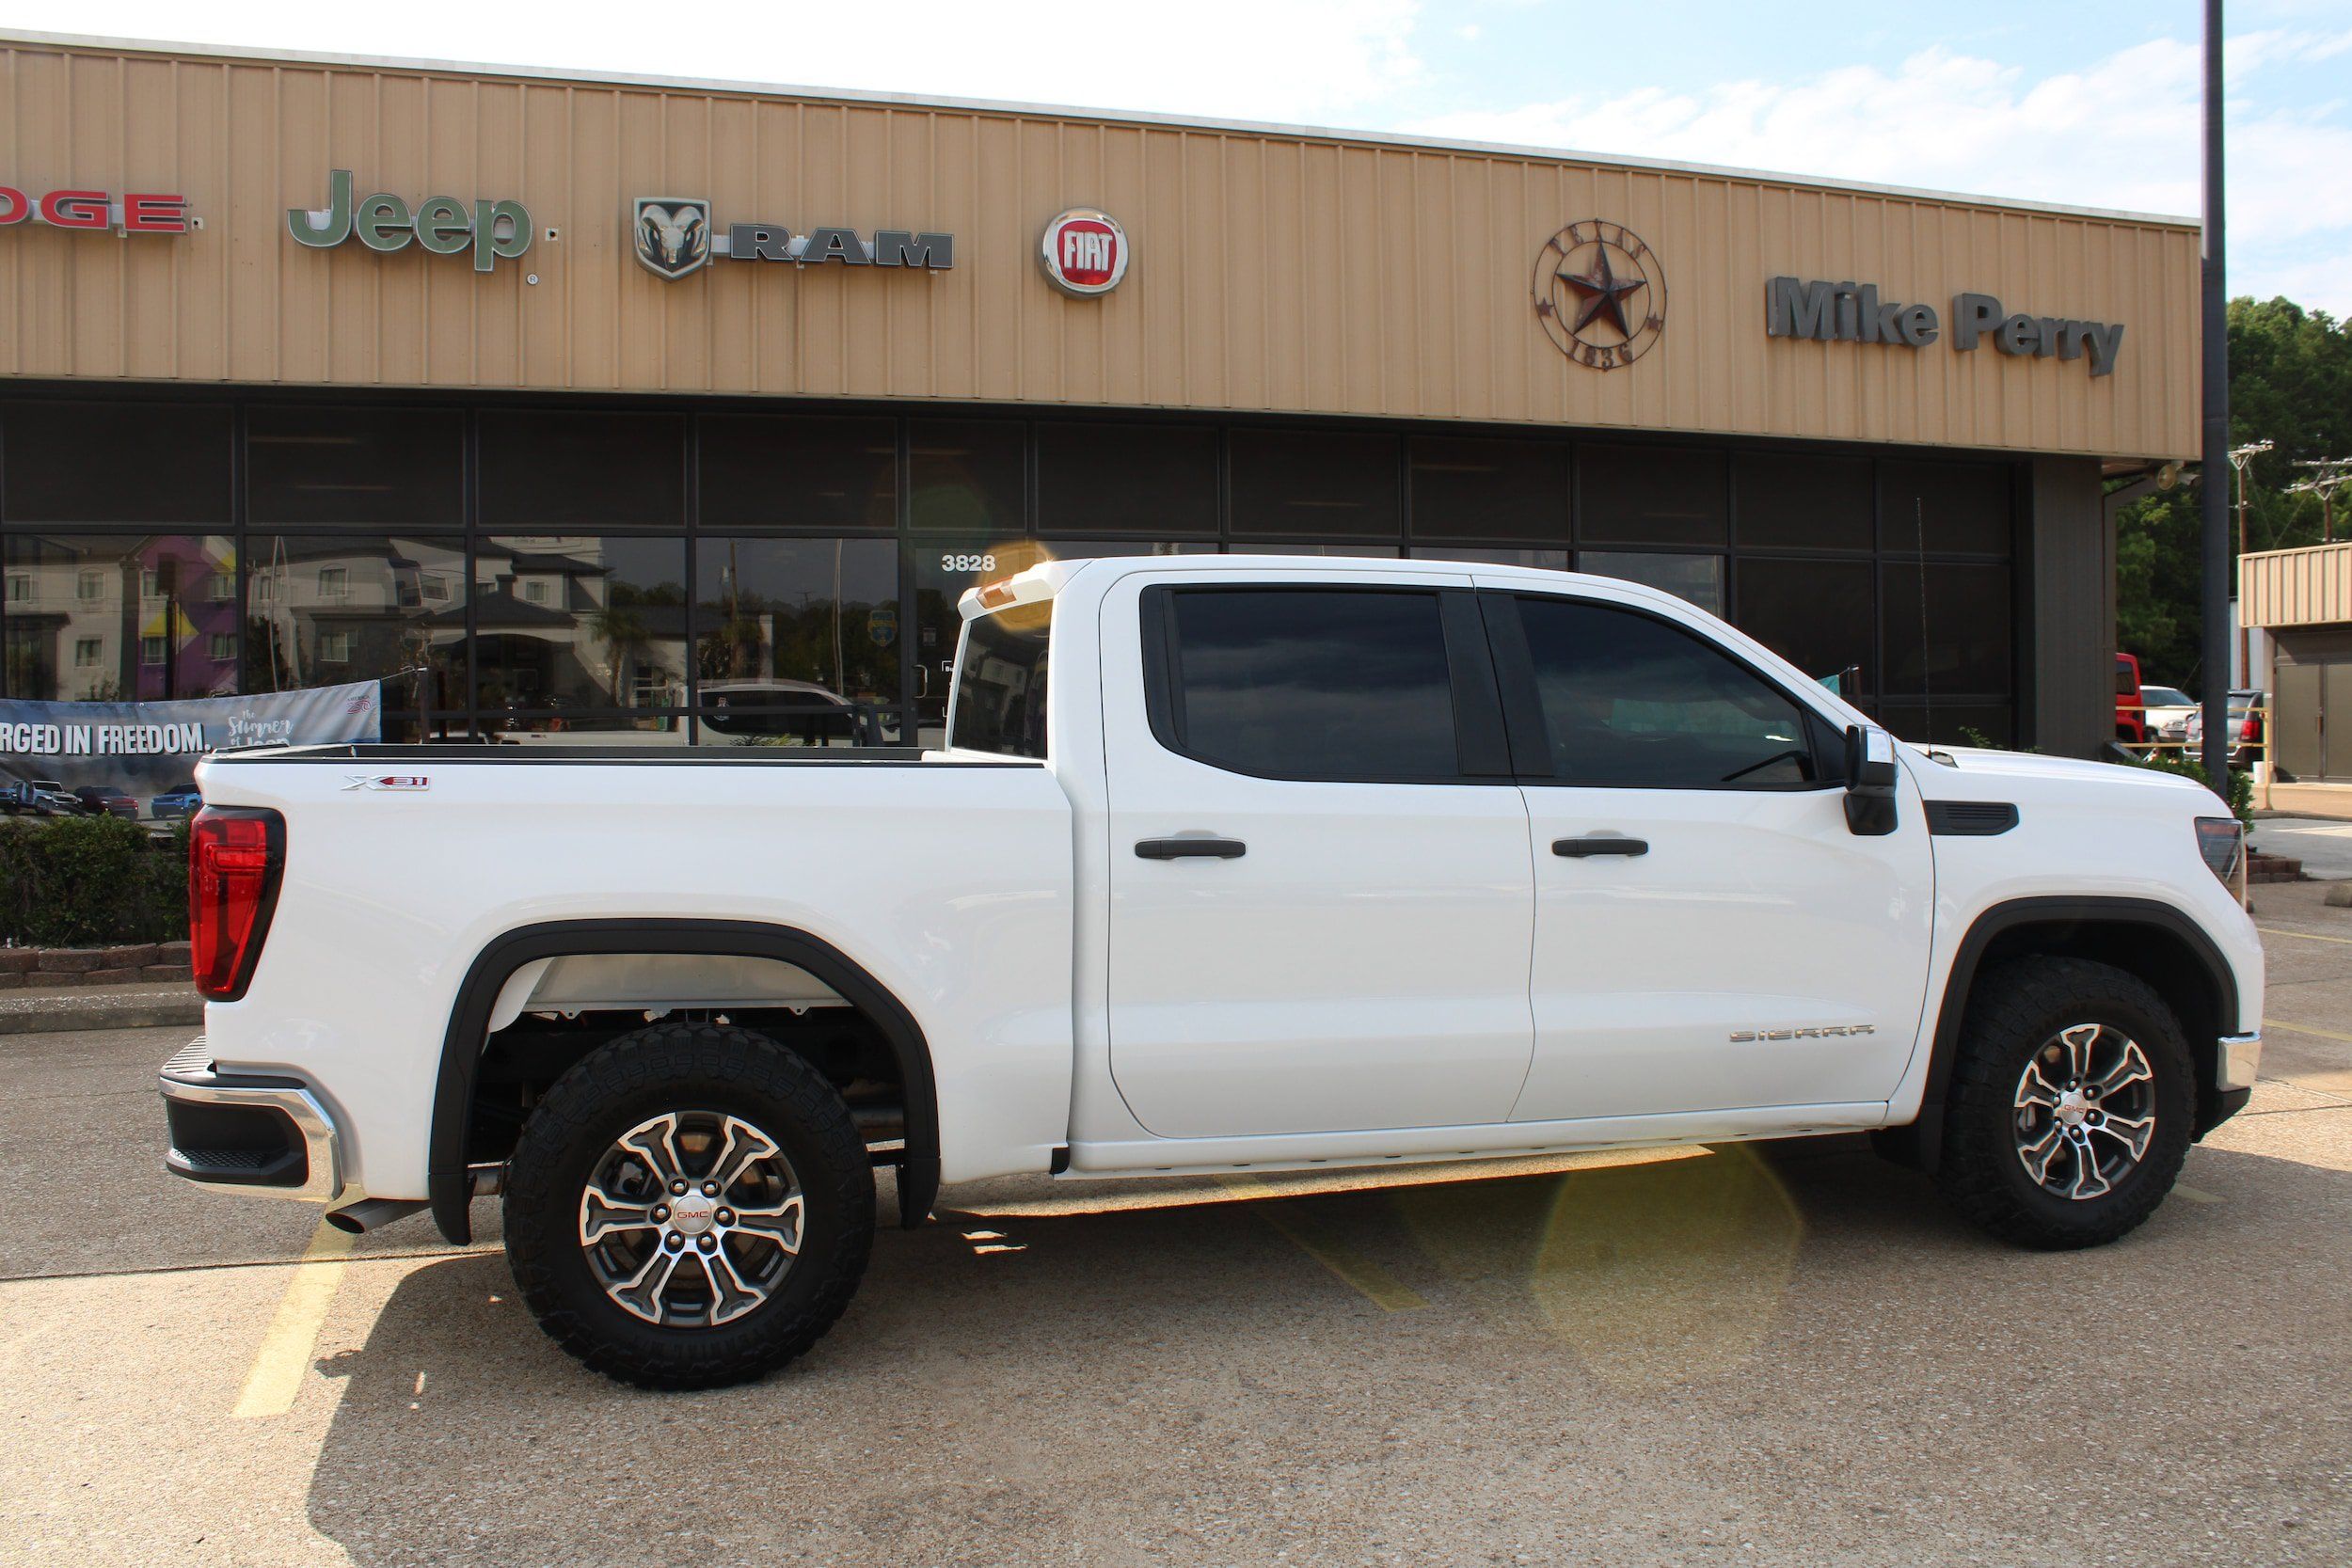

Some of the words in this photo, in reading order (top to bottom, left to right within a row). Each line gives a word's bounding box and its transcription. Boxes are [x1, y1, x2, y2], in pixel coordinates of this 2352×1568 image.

[287, 169, 533, 273] Jeep
[729, 223, 954, 269] RAM
[1063, 230, 1113, 272] FIAT
[1766, 276, 1939, 347] Mike
[1952, 293, 2124, 376] Perry
[942, 554, 996, 572] 3828
[65, 724, 92, 754] IN
[98, 722, 213, 754] FREEDOM.
[1729, 1023, 1876, 1042] SIERRA
[677, 1210, 709, 1219] GMC
